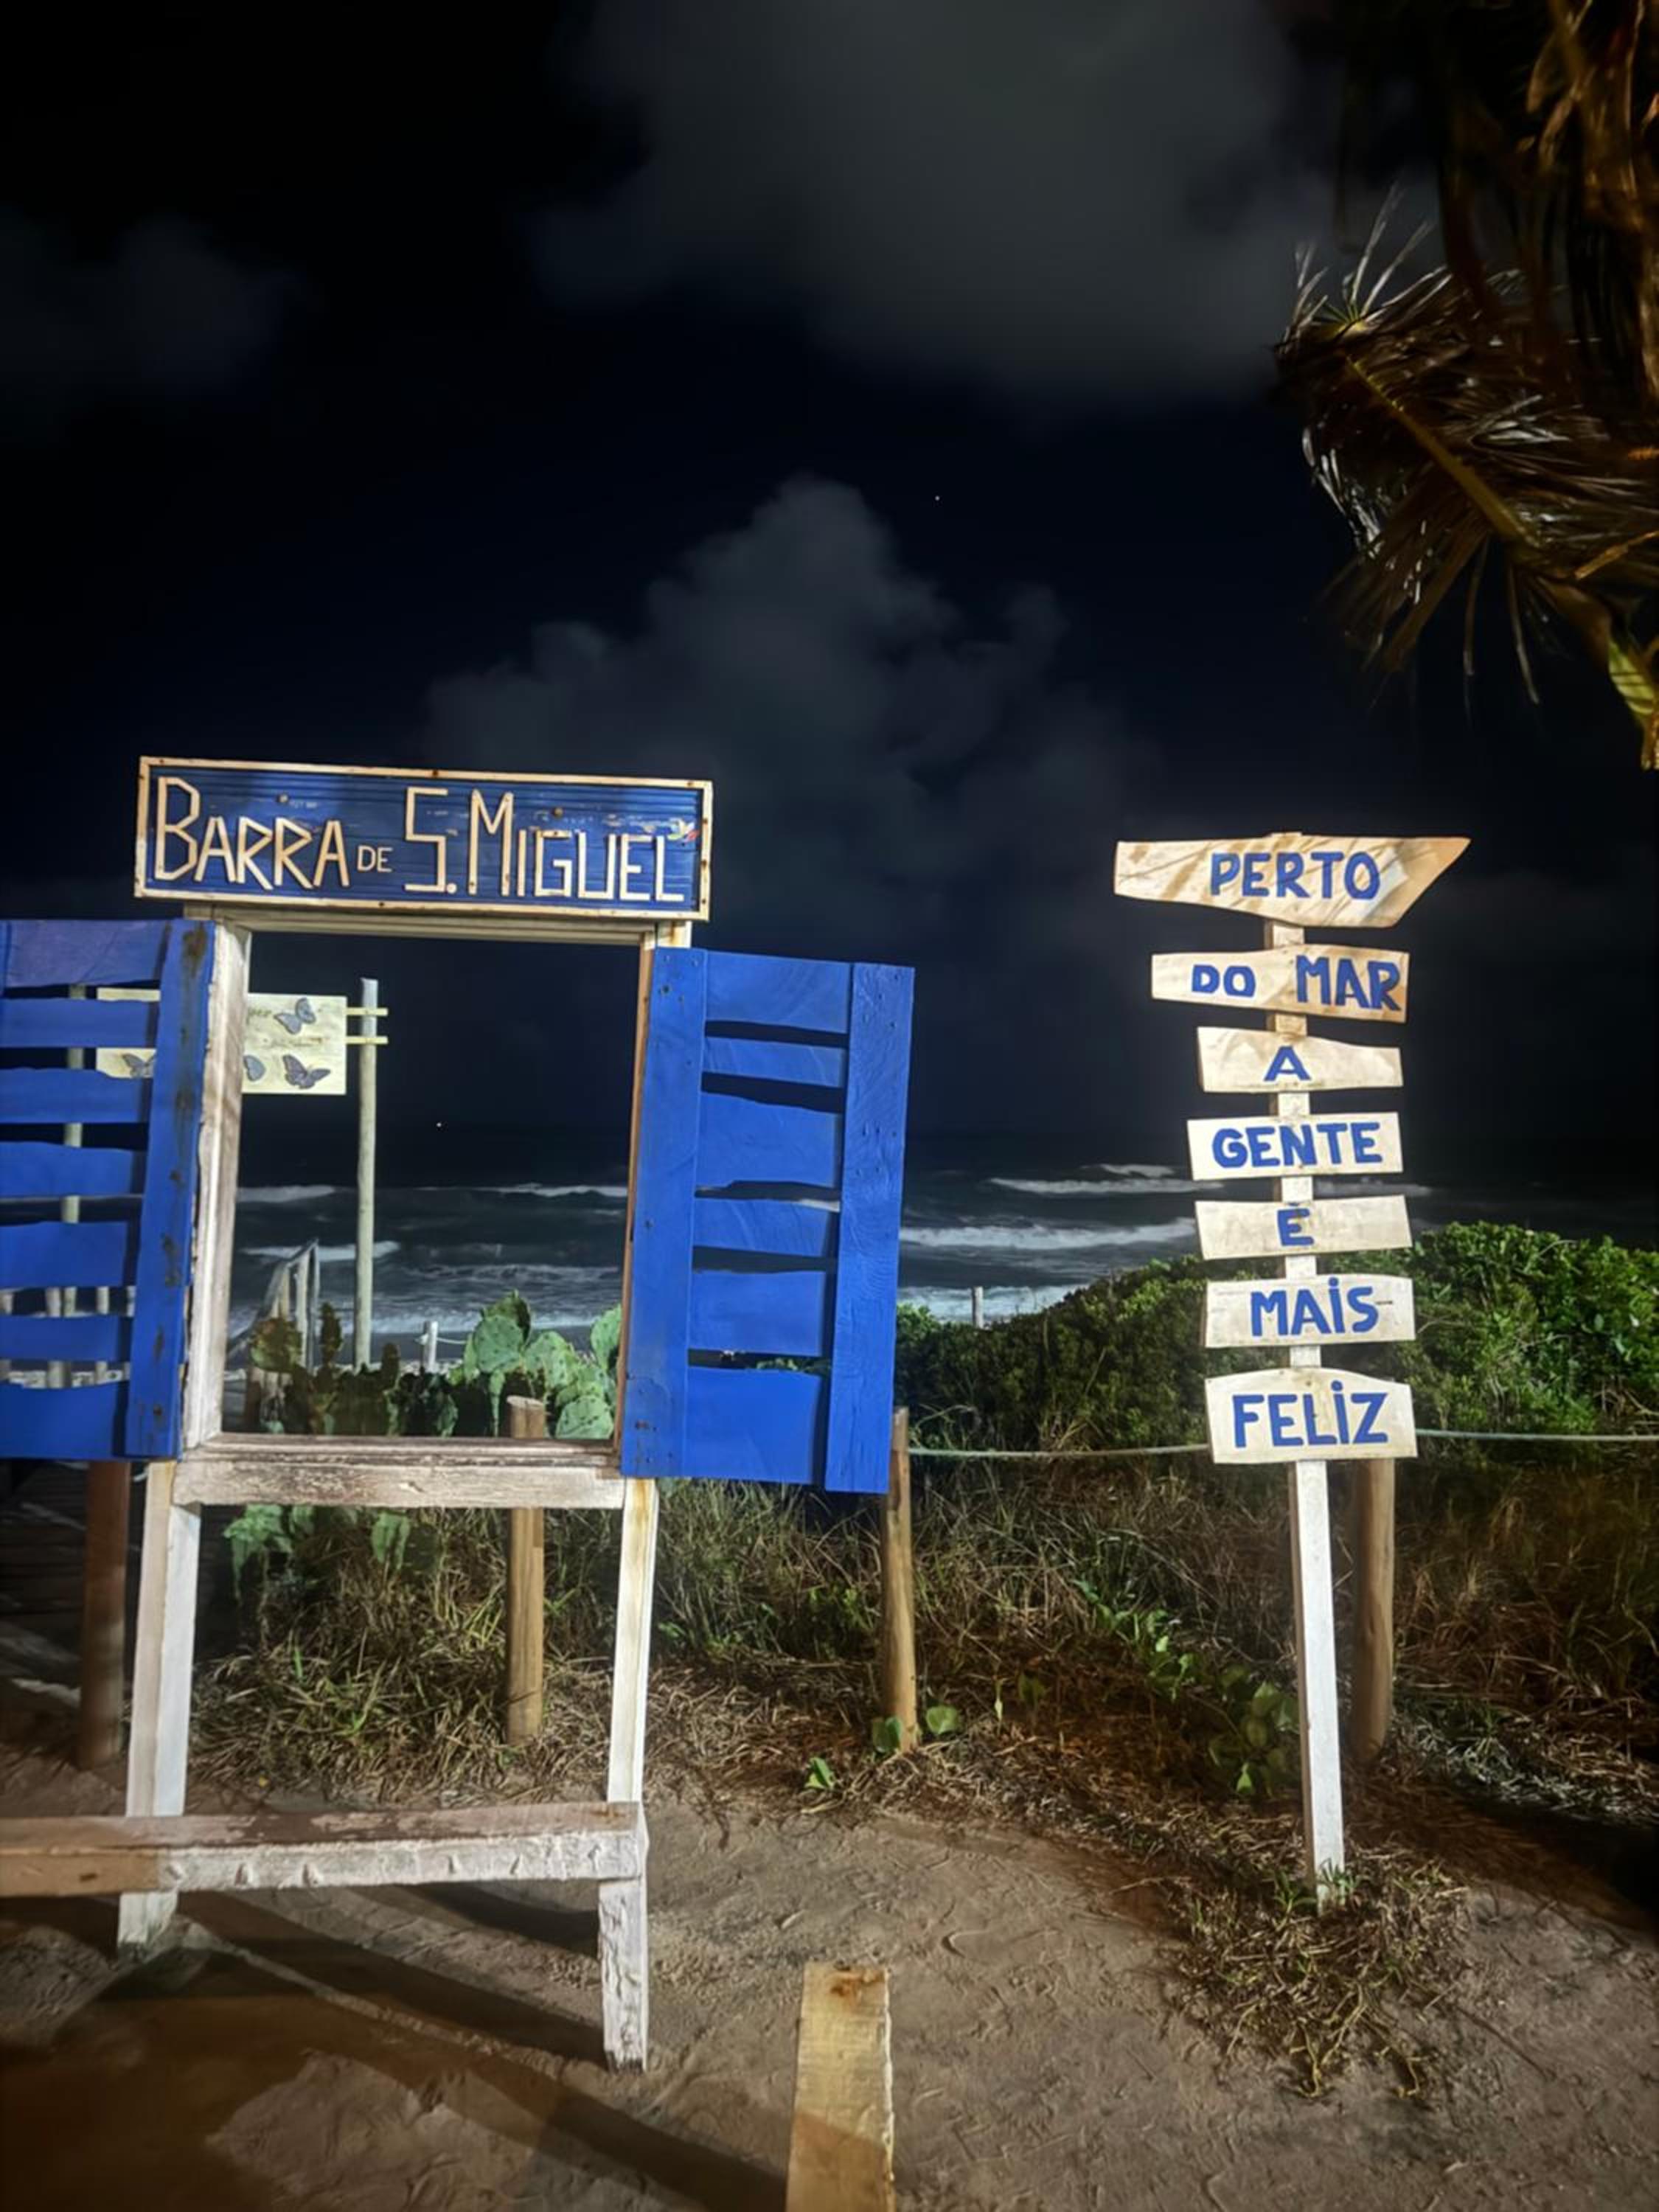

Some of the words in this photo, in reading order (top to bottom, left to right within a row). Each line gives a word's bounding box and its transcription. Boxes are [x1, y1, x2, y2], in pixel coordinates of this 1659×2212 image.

[154, 776, 349, 891] BARRA
[357, 844, 393, 873] DE
[467, 789, 686, 902] MIGUEL
[1210, 852, 1381, 900] PERTO
[1191, 964, 1256, 998] DO
[1295, 954, 1402, 1012] MAR
[1264, 1046, 1311, 1082] A
[1211, 1121, 1382, 1169] GENTE
